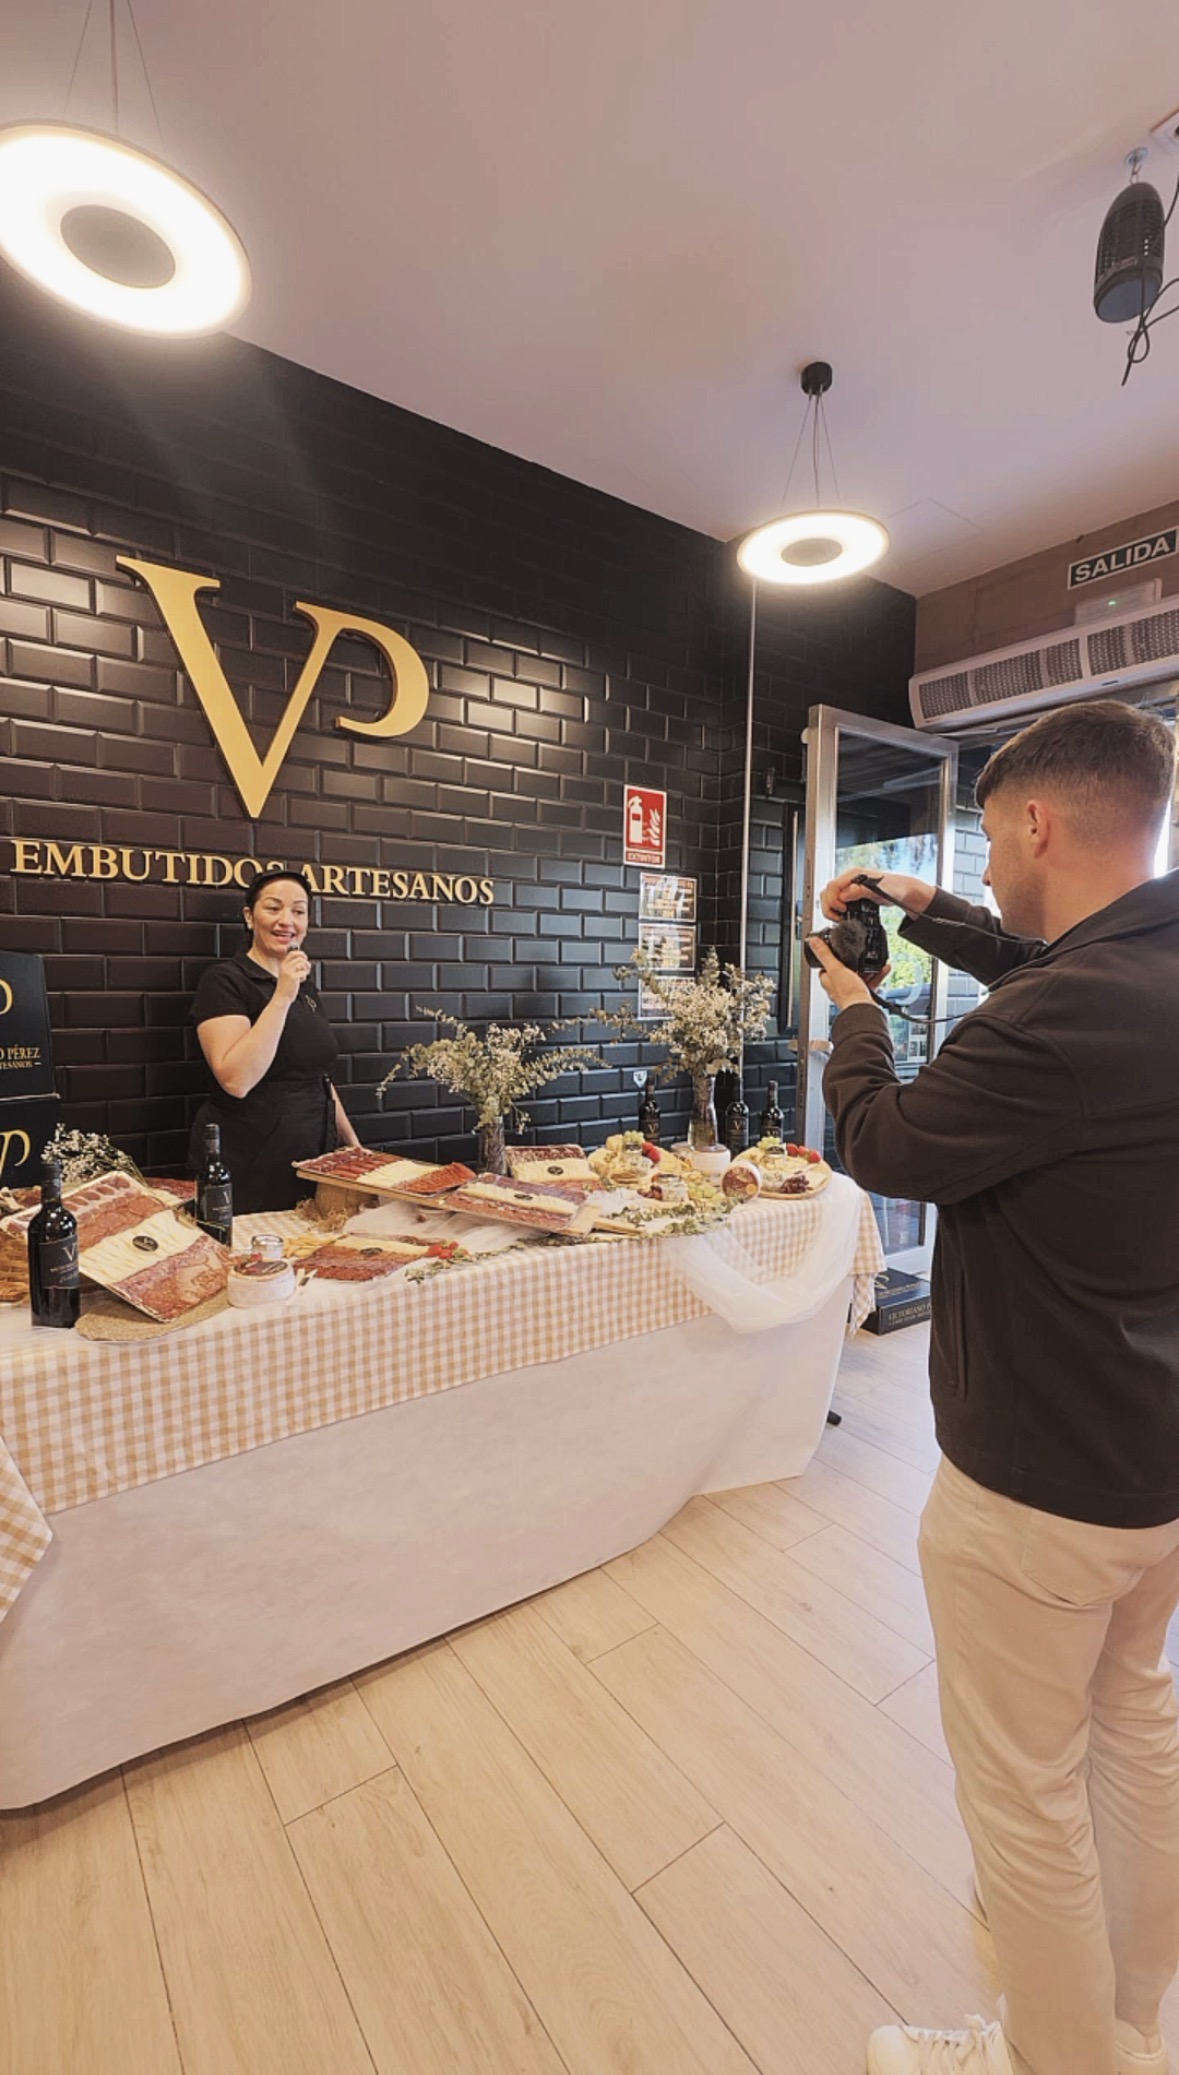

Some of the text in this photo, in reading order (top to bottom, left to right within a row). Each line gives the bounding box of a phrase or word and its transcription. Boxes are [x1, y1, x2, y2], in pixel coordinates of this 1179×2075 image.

[1074, 536, 1171, 582] SALIDA
[300, 863, 495, 905] ARTESANOS
[7, 1044, 41, 1060] PÉREZ
